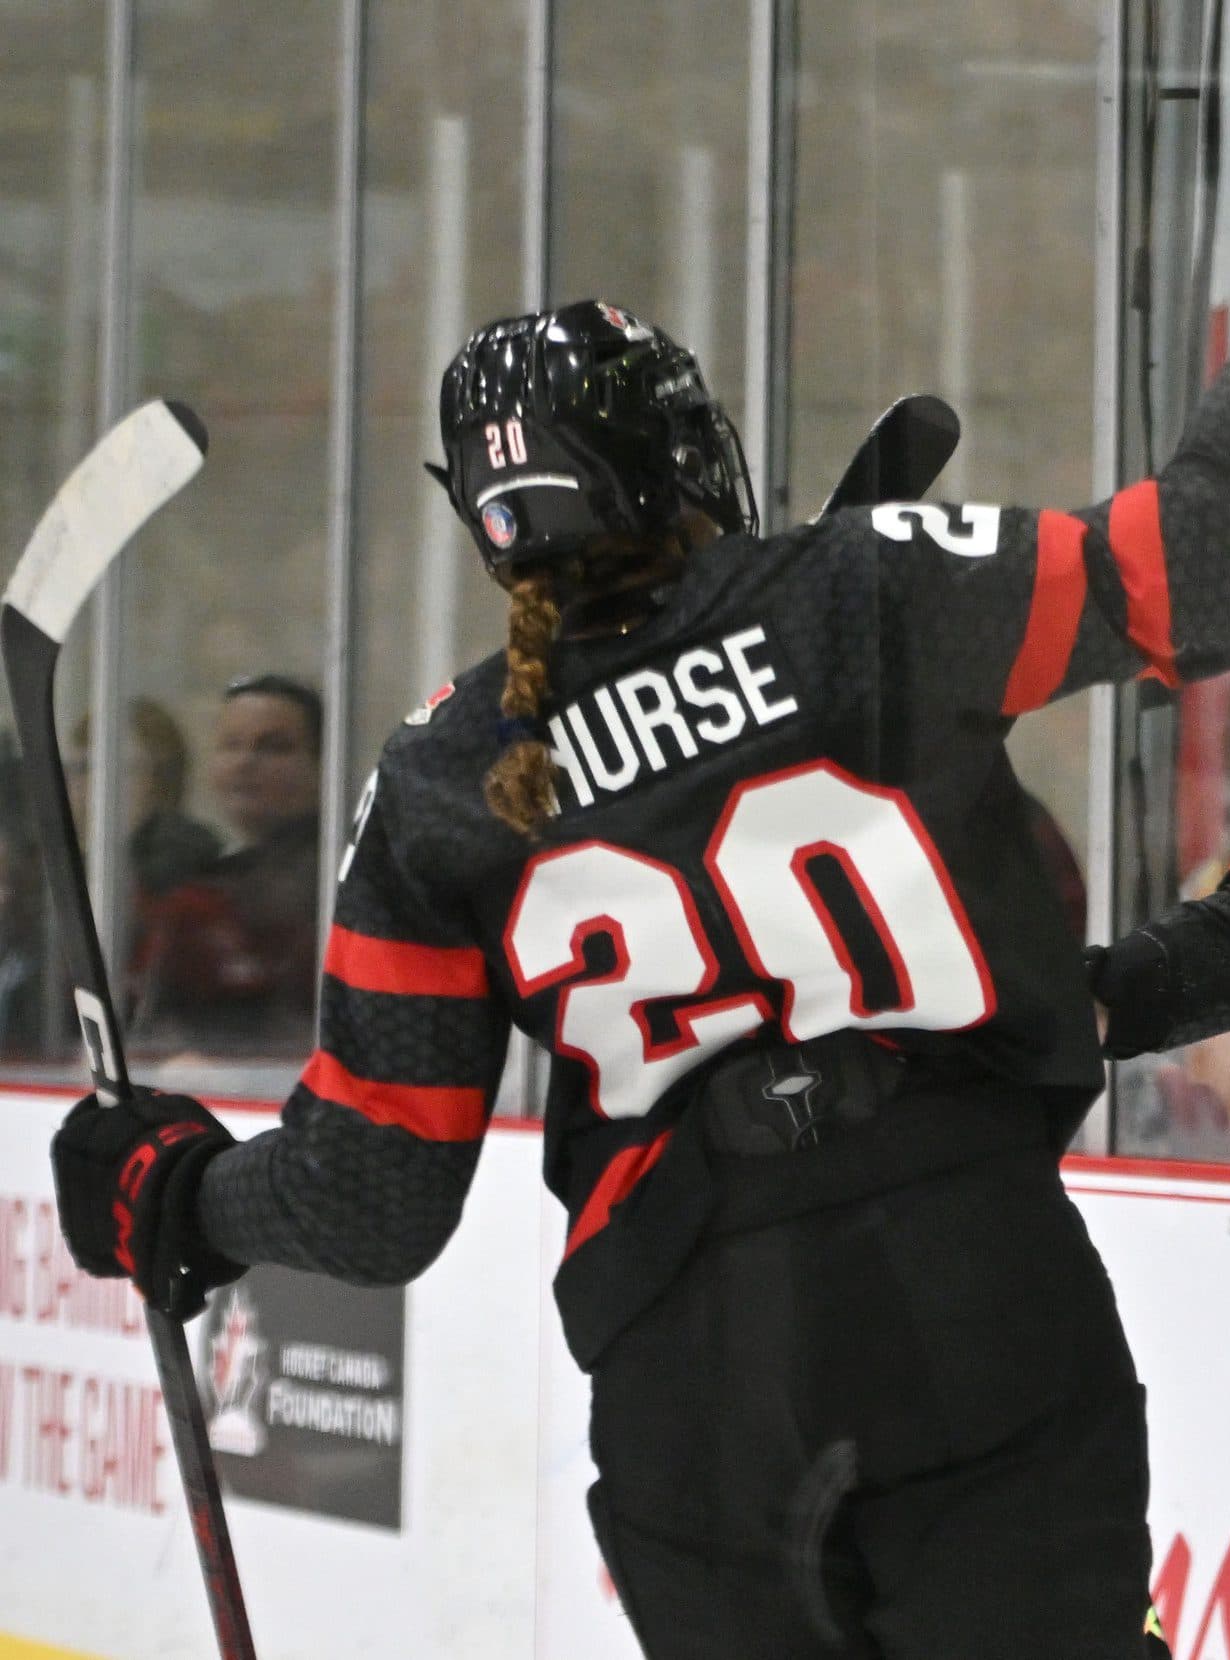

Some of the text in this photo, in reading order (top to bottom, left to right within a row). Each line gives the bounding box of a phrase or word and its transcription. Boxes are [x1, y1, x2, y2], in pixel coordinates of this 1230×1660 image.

[485, 415, 528, 470] 20
[547, 626, 799, 818] HURSE
[503, 757, 997, 1121] 20
[268, 1381, 396, 1448] FOUNDATION
